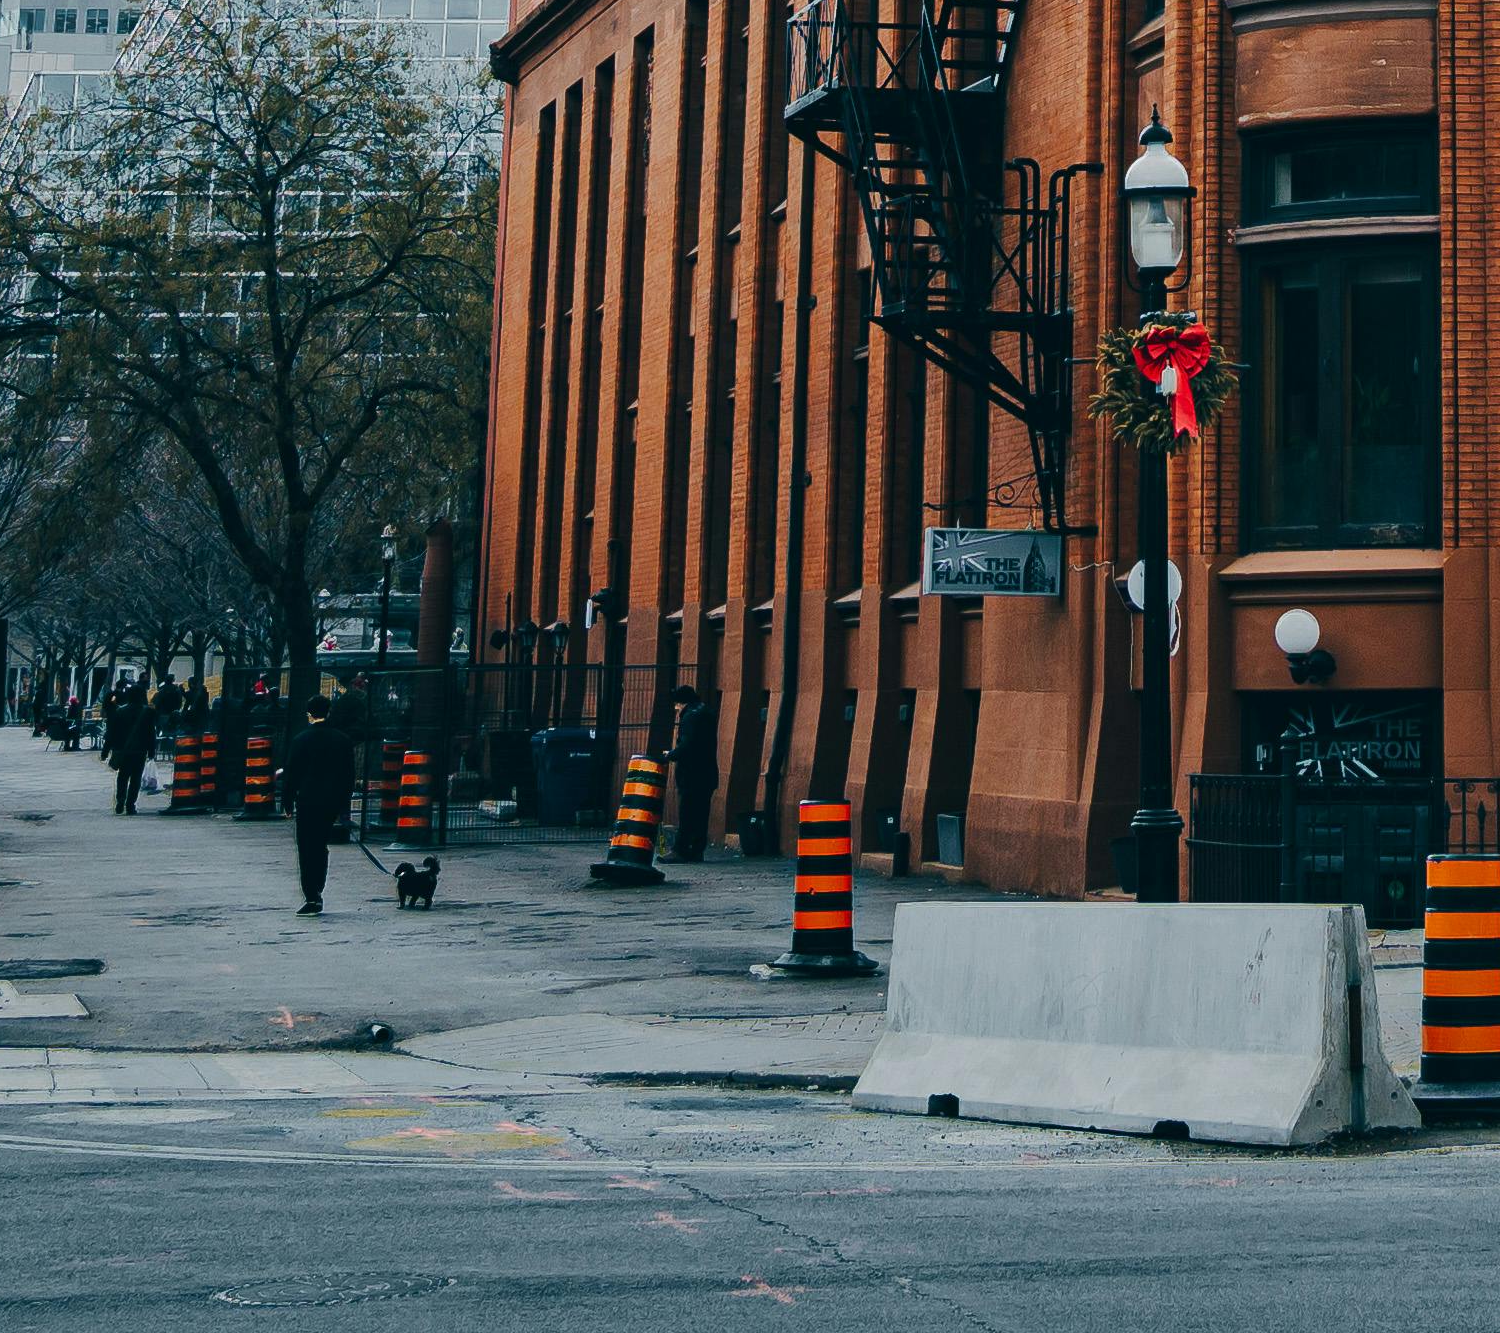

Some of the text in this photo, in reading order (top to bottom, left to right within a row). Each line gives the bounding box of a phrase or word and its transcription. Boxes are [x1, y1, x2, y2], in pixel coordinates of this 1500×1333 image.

[984, 557, 1021, 571] THE
[933, 571, 1021, 585] FLATIRON
[1371, 718, 1421, 738] THE
[1300, 740, 1421, 760] FLATIRON
